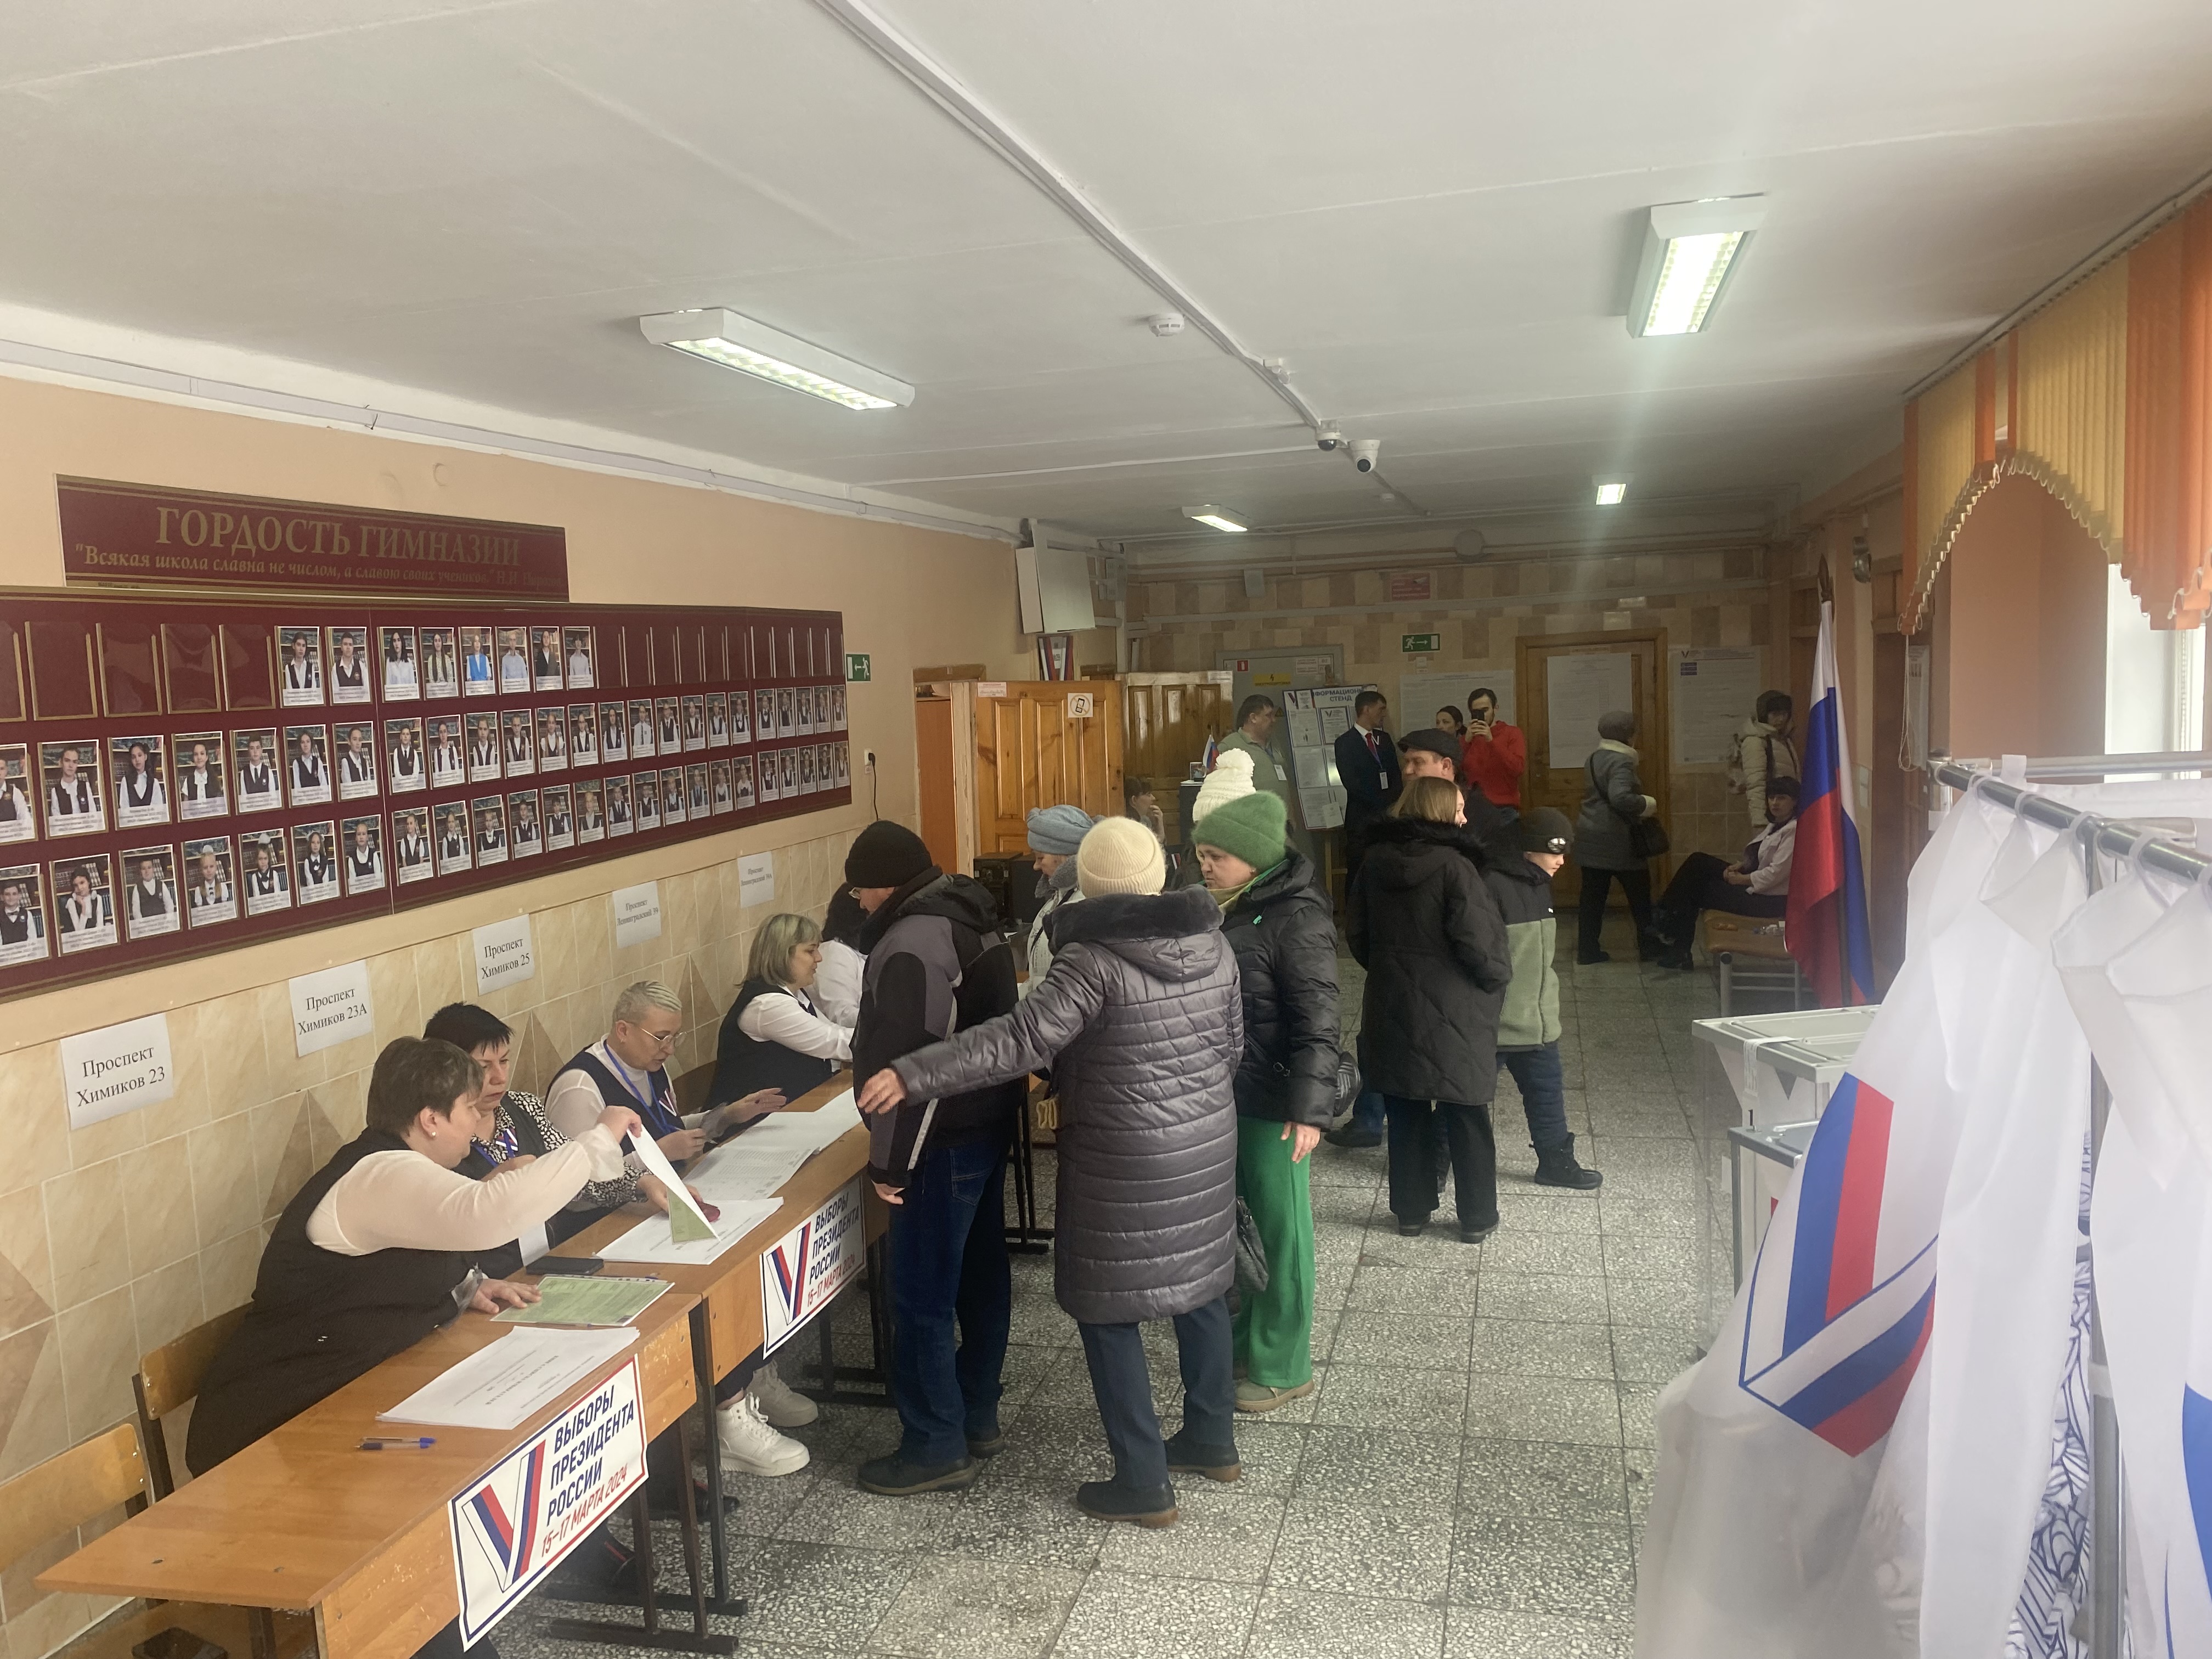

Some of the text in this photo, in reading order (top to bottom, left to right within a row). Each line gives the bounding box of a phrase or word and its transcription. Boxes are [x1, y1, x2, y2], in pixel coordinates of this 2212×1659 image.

[155, 506, 521, 567] ГОРДОСТЬ ГИМНАЗИИ
[155, 554, 208, 571] школа
[213, 557, 265, 573] славна
[269, 561, 285, 574] не
[289, 563, 341, 580] числом,
[345, 567, 352, 577] а
[356, 566, 400, 581] славою
[403, 569, 435, 582] своих
[481, 953, 530, 979] Химиков 25
[484, 939, 523, 958] Проспект
[298, 1003, 368, 1035] Химиков 23А
[306, 989, 356, 1012] Проспект
[82, 1047, 154, 1078] Проспект
[76, 1066, 165, 1107] Химиков 23
[1748, 1109, 1753, 1126] 1
[812, 1205, 860, 1260] ПРЕЗИДЕНТА
[815, 1192, 849, 1234] ВЫБОРЫ
[809, 1243, 840, 1285] РОССИИ
[823, 1263, 842, 1291] МАРТА
[842, 1252, 855, 1274] 2024
[554, 1385, 615, 1454] ВЫБОРЫ
[550, 1400, 634, 1491] ПРЕЗИДЕНТА
[547, 1457, 602, 1527] РОССИИ
[571, 1486, 605, 1531] МАРТА
[605, 1463, 628, 1502] 2024
